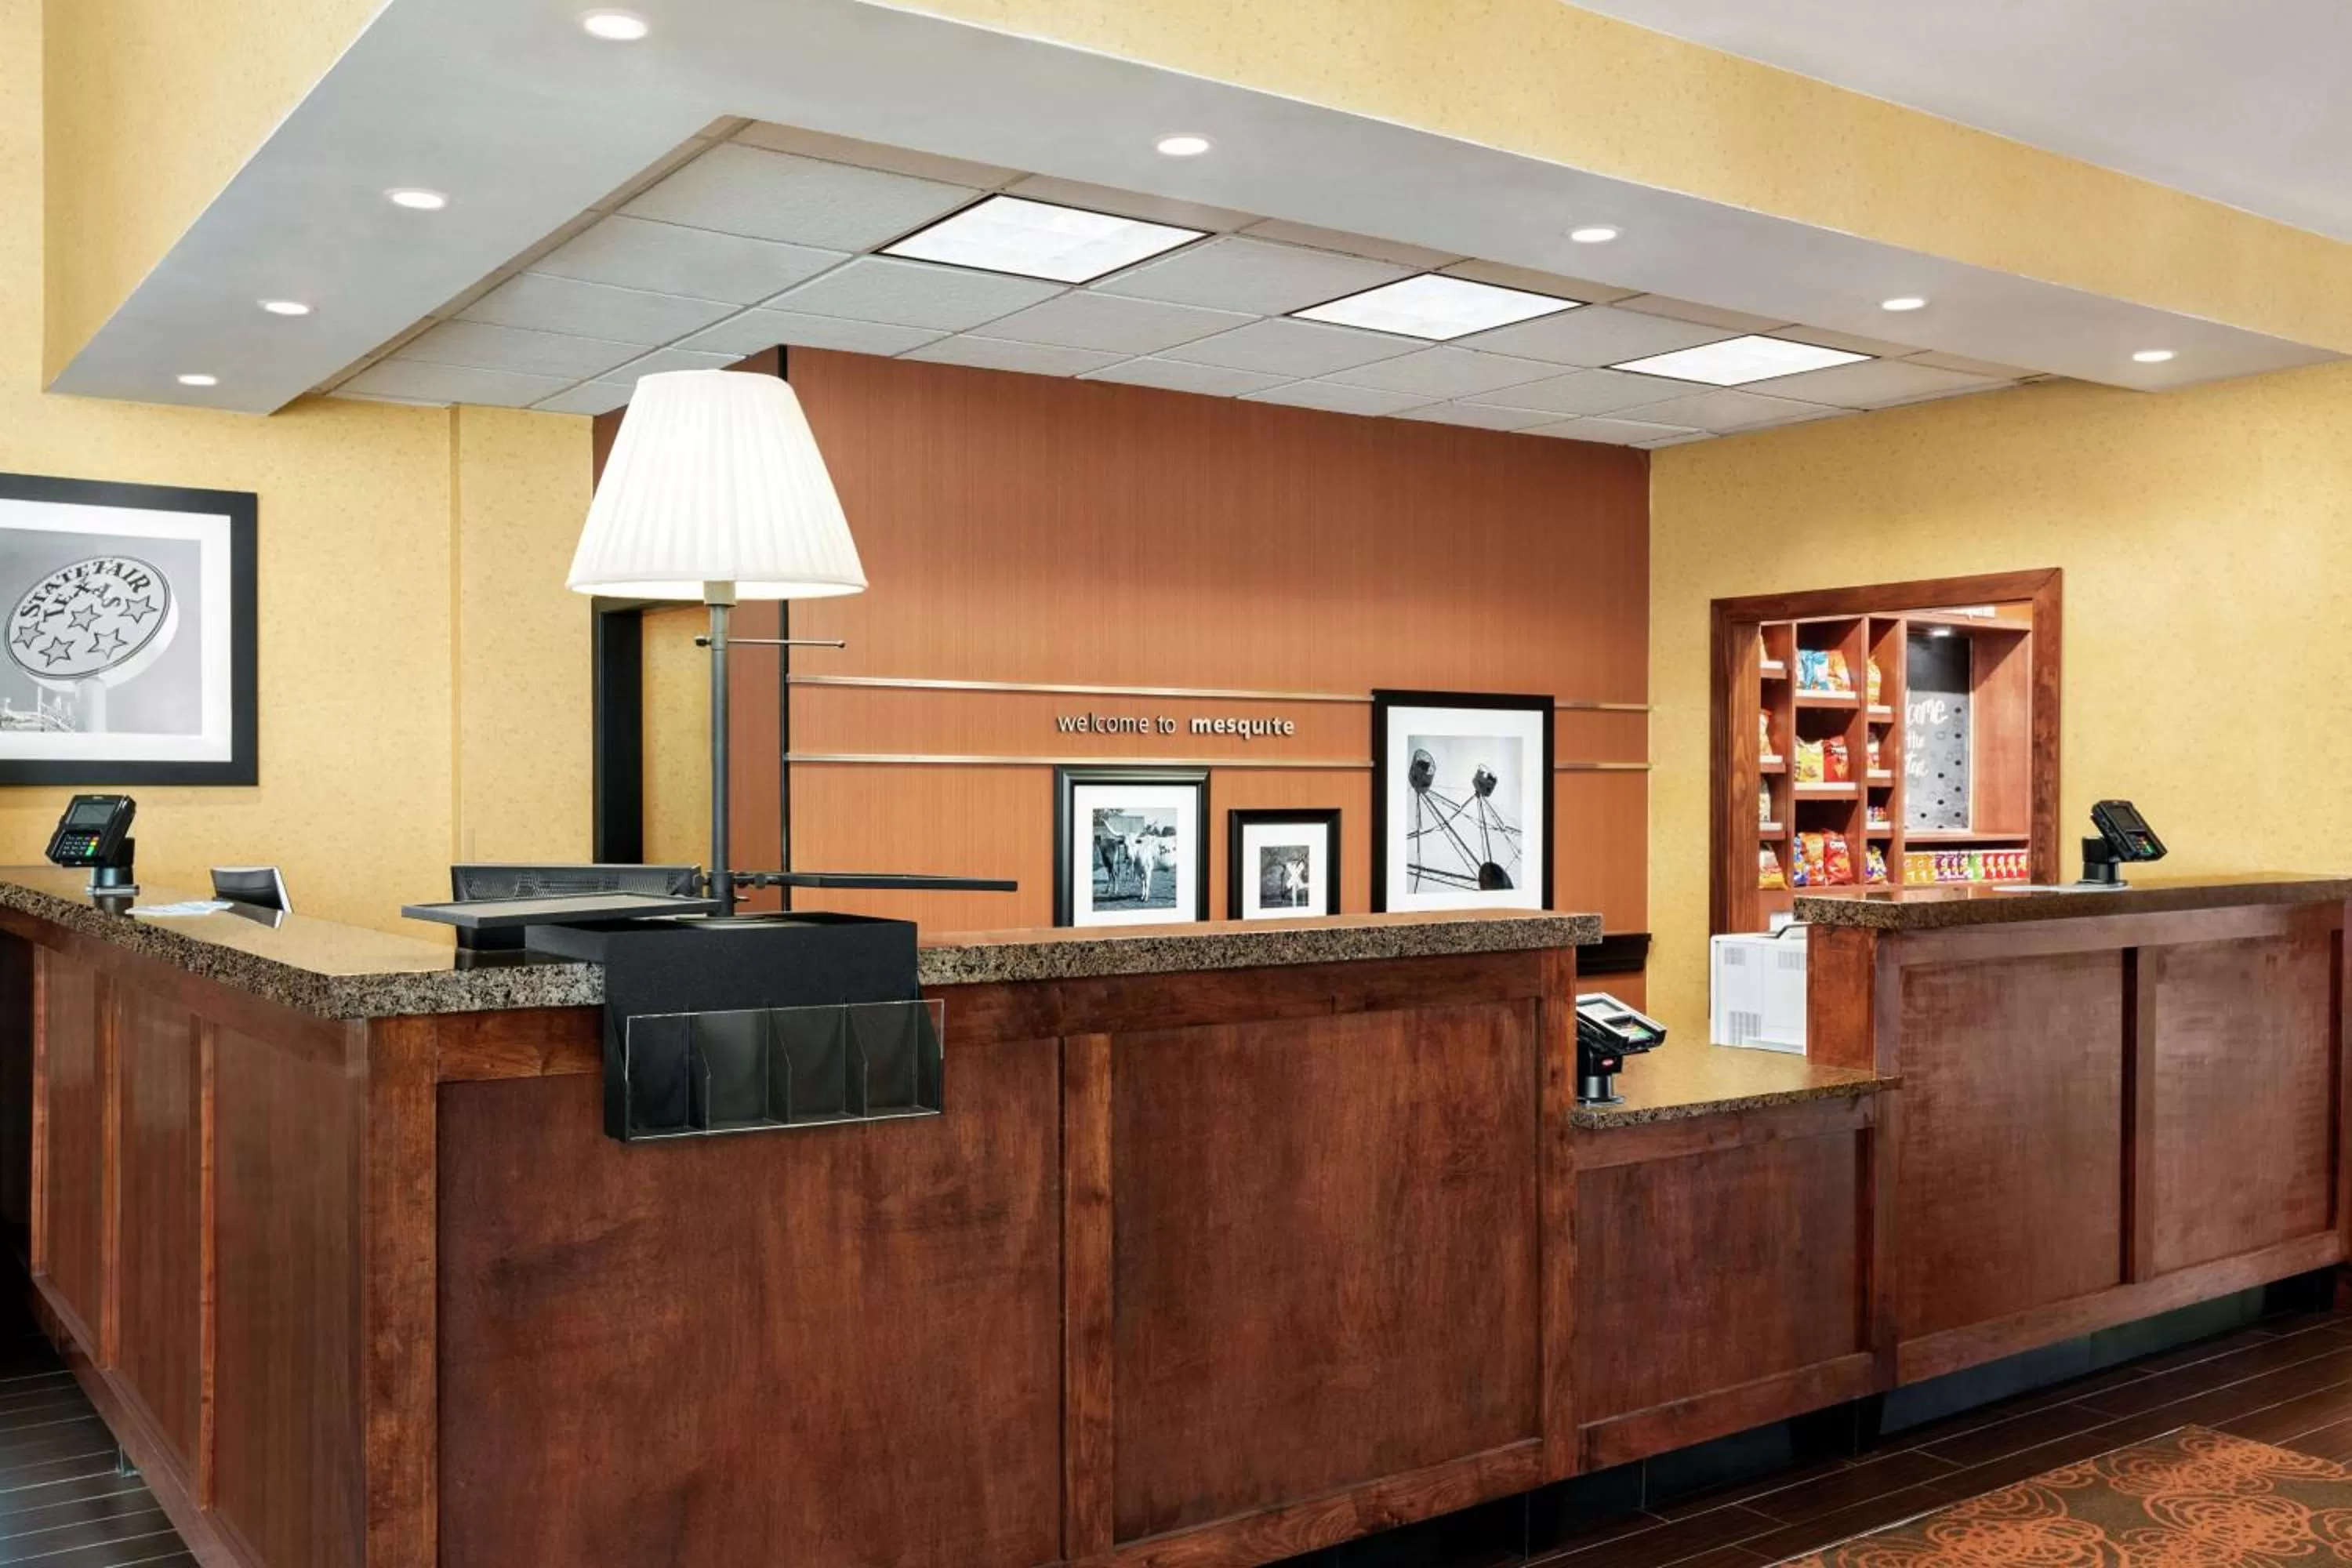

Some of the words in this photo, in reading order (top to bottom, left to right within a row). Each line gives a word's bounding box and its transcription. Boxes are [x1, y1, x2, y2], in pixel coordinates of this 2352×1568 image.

[20, 563, 89, 618] STATE
[93, 560, 151, 593] FAIR
[42, 581, 122, 622] TEXAS
[1057, 713, 1149, 733] welcome
[1156, 715, 1177, 734] to
[1190, 716, 1295, 739] mesquite
